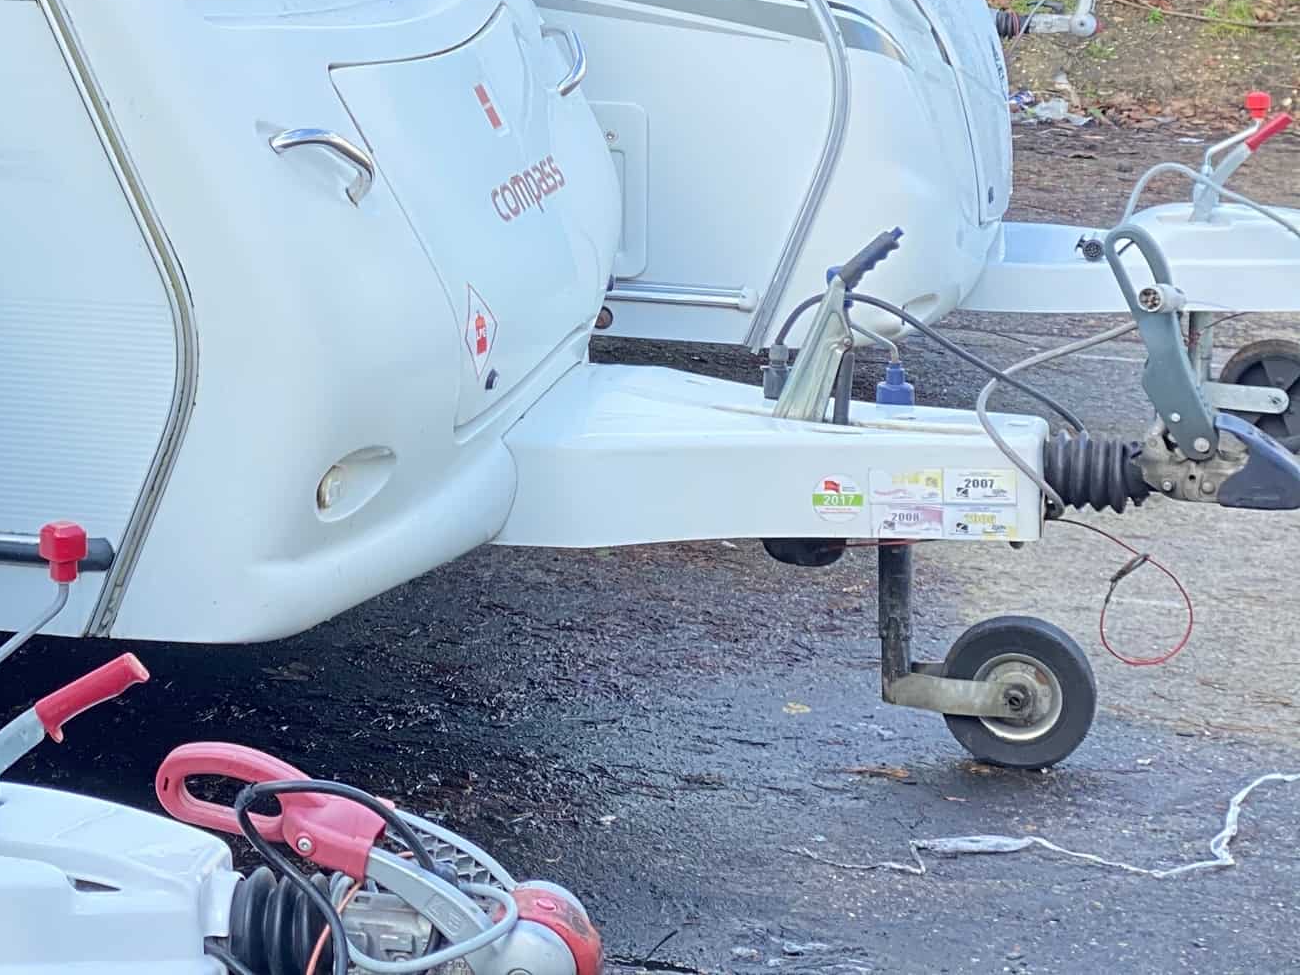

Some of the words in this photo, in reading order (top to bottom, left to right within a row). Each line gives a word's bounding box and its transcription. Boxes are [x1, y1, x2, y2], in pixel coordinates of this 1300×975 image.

[491, 154, 566, 222] compass
[964, 478, 995, 489] 2007
[823, 495, 855, 506] 2017
